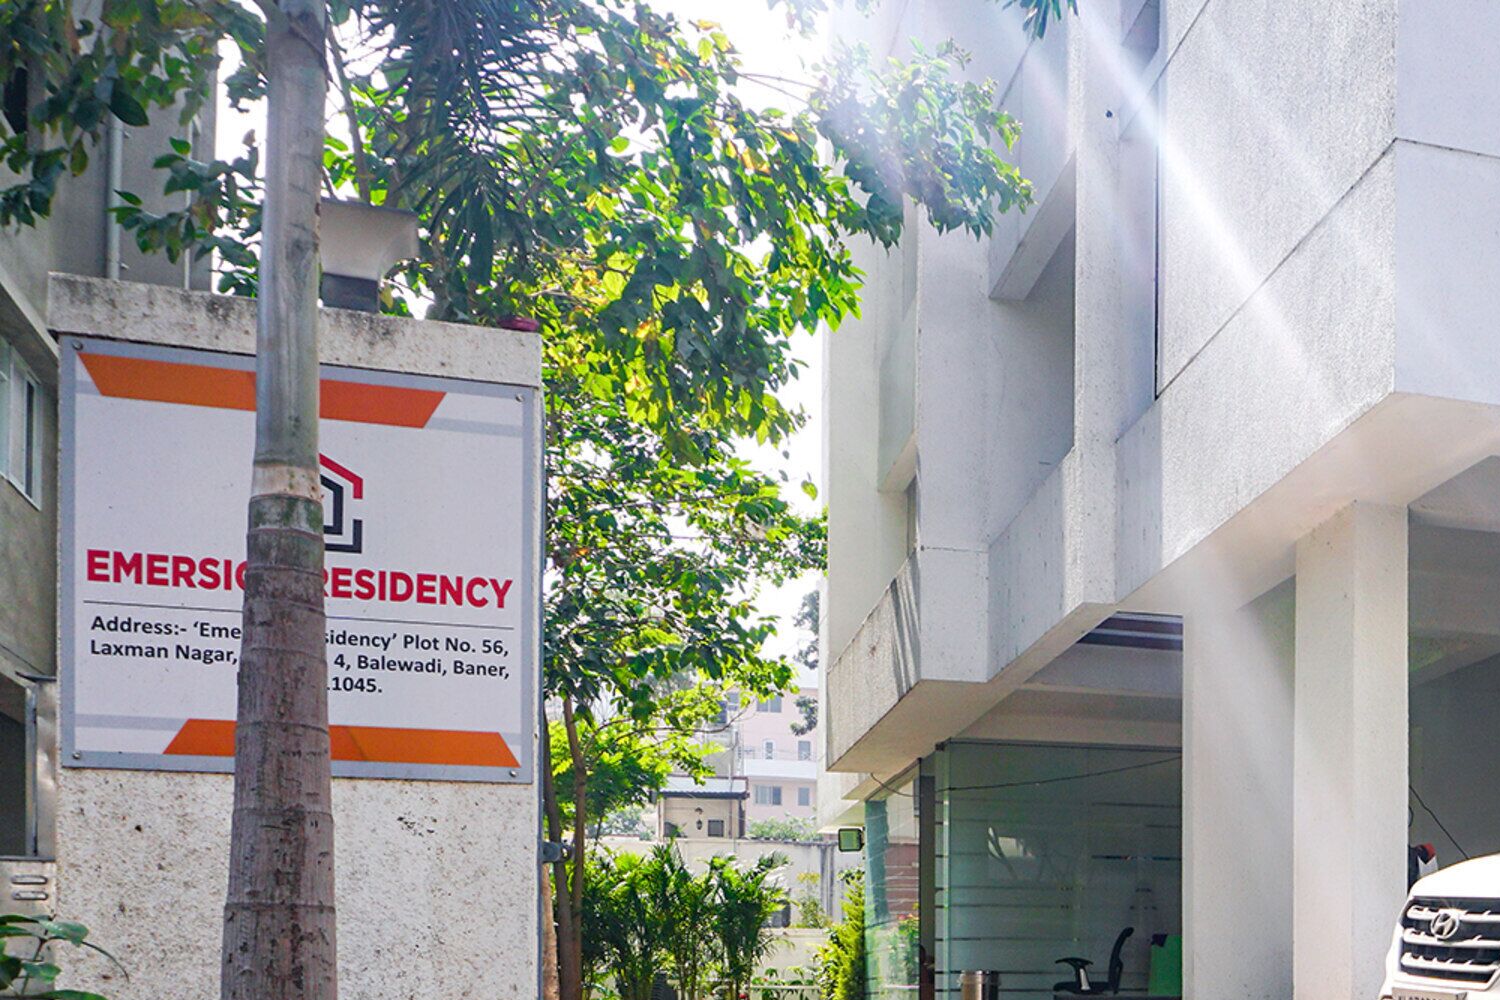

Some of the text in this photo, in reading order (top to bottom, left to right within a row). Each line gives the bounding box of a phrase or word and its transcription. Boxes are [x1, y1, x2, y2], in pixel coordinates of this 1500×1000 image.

[87, 549, 513, 609] EMERSI ESIDENCY
[91, 615, 187, 636] Address:-
[404, 634, 439, 651] Plot
[445, 637, 476, 653] No.
[482, 639, 509, 657] 56,
[91, 640, 168, 659] Laxman
[176, 644, 237, 665] Nagar,
[357, 655, 447, 676] Balewadi,
[453, 660, 510, 680] Baner,
[327, 677, 383, 693] 1045.
